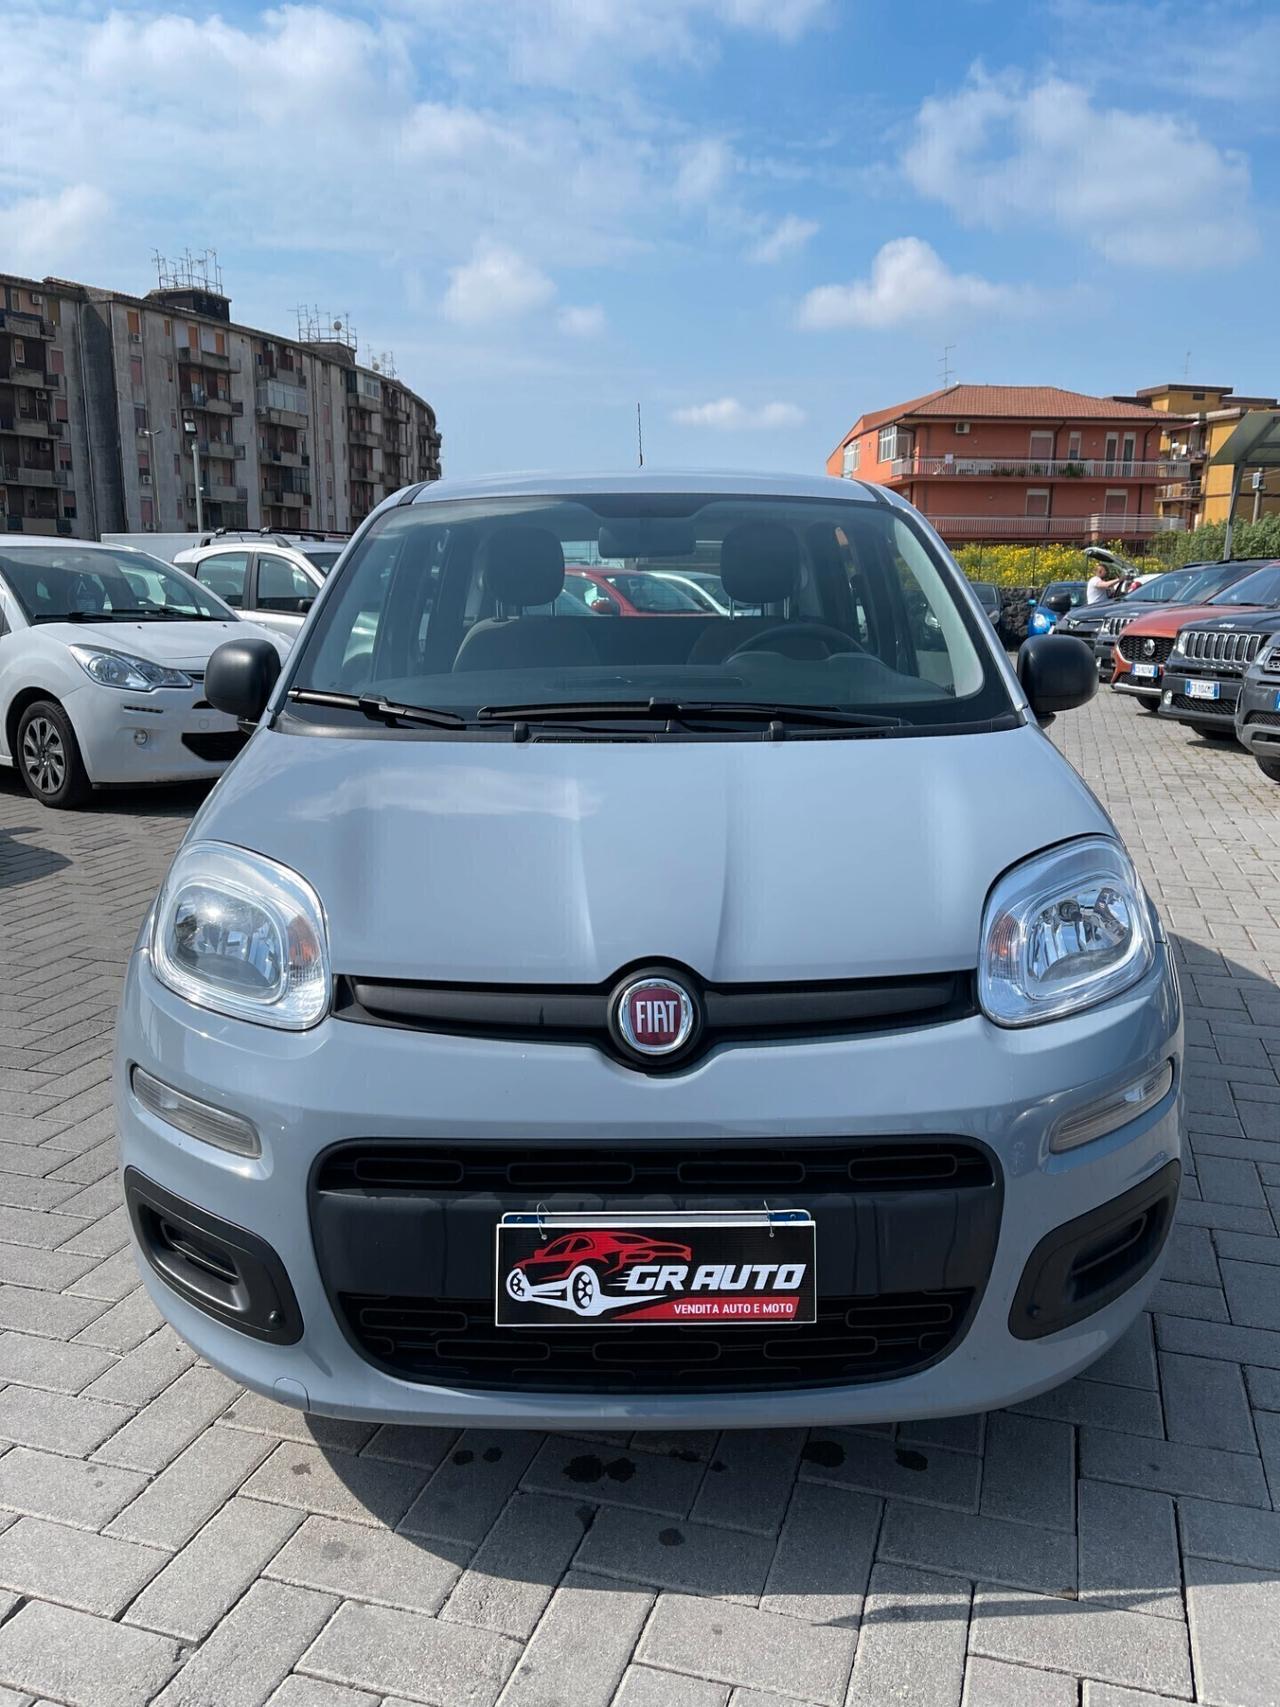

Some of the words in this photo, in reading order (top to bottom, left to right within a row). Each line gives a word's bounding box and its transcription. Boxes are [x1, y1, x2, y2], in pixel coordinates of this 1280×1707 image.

[636, 1001, 678, 1033] FIAT
[625, 1265, 688, 1291] GR
[690, 1264, 807, 1291] AUTO
[674, 1304, 720, 1315] VENDITA
[722, 1304, 751, 1314] AUTO
[754, 1304, 760, 1313] E
[763, 1303, 793, 1313] MOTO
